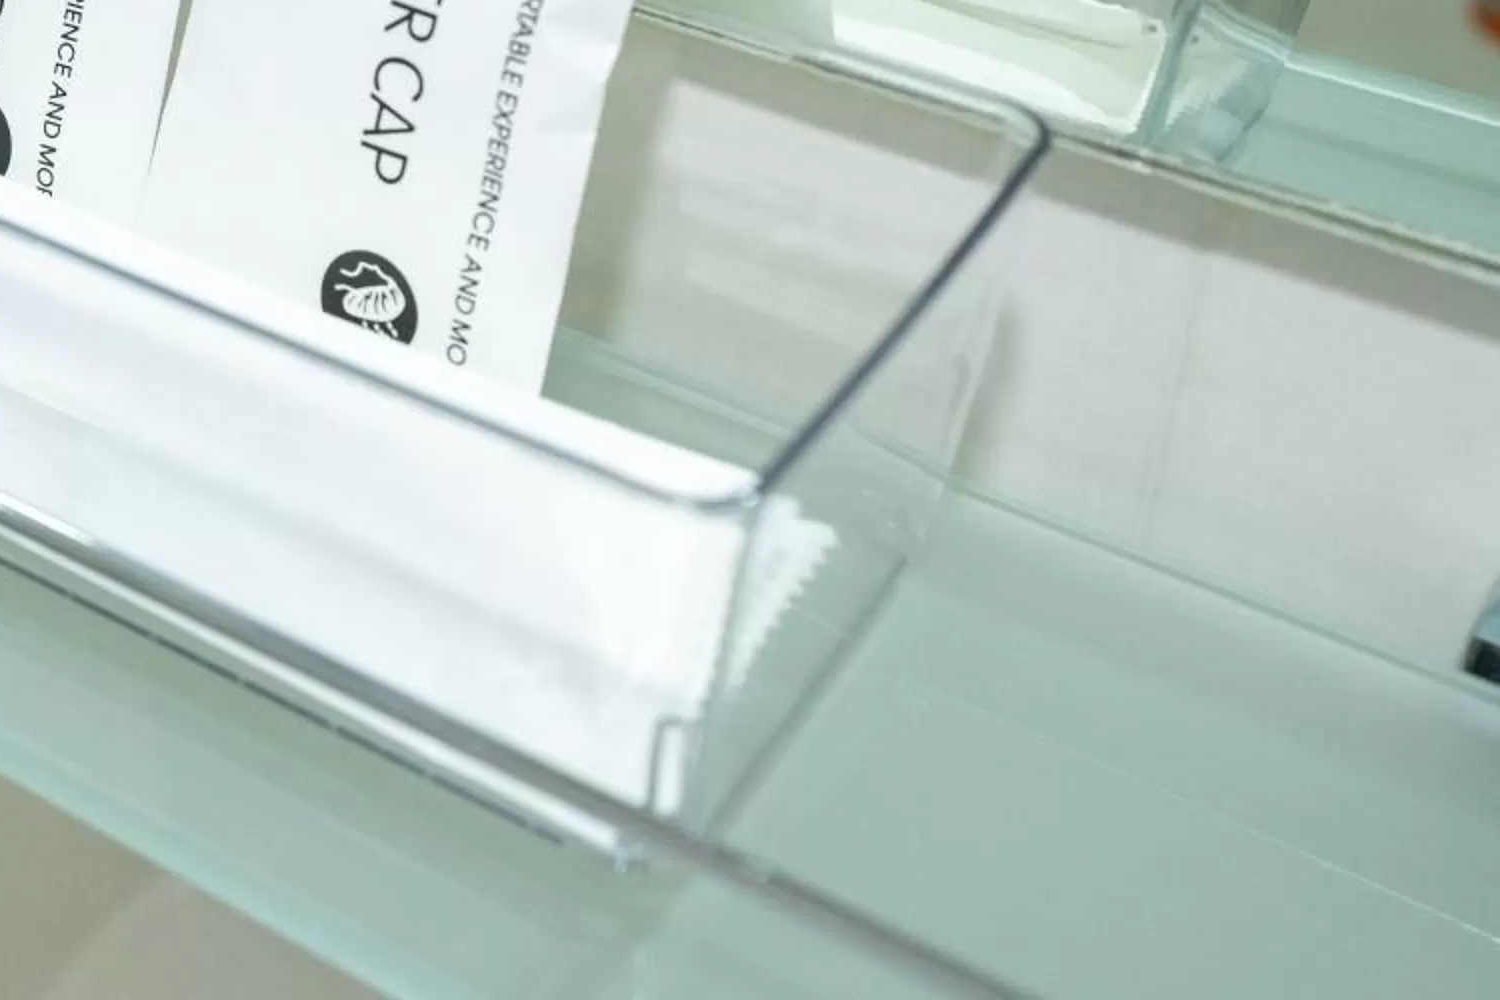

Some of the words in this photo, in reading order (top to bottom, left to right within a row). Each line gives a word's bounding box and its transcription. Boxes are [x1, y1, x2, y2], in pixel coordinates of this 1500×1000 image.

[42, 81, 68, 140] AND
[360, 56, 424, 185] CAP
[466, 90, 519, 252] EXPERIENCE
[453, 252, 483, 318] AND
